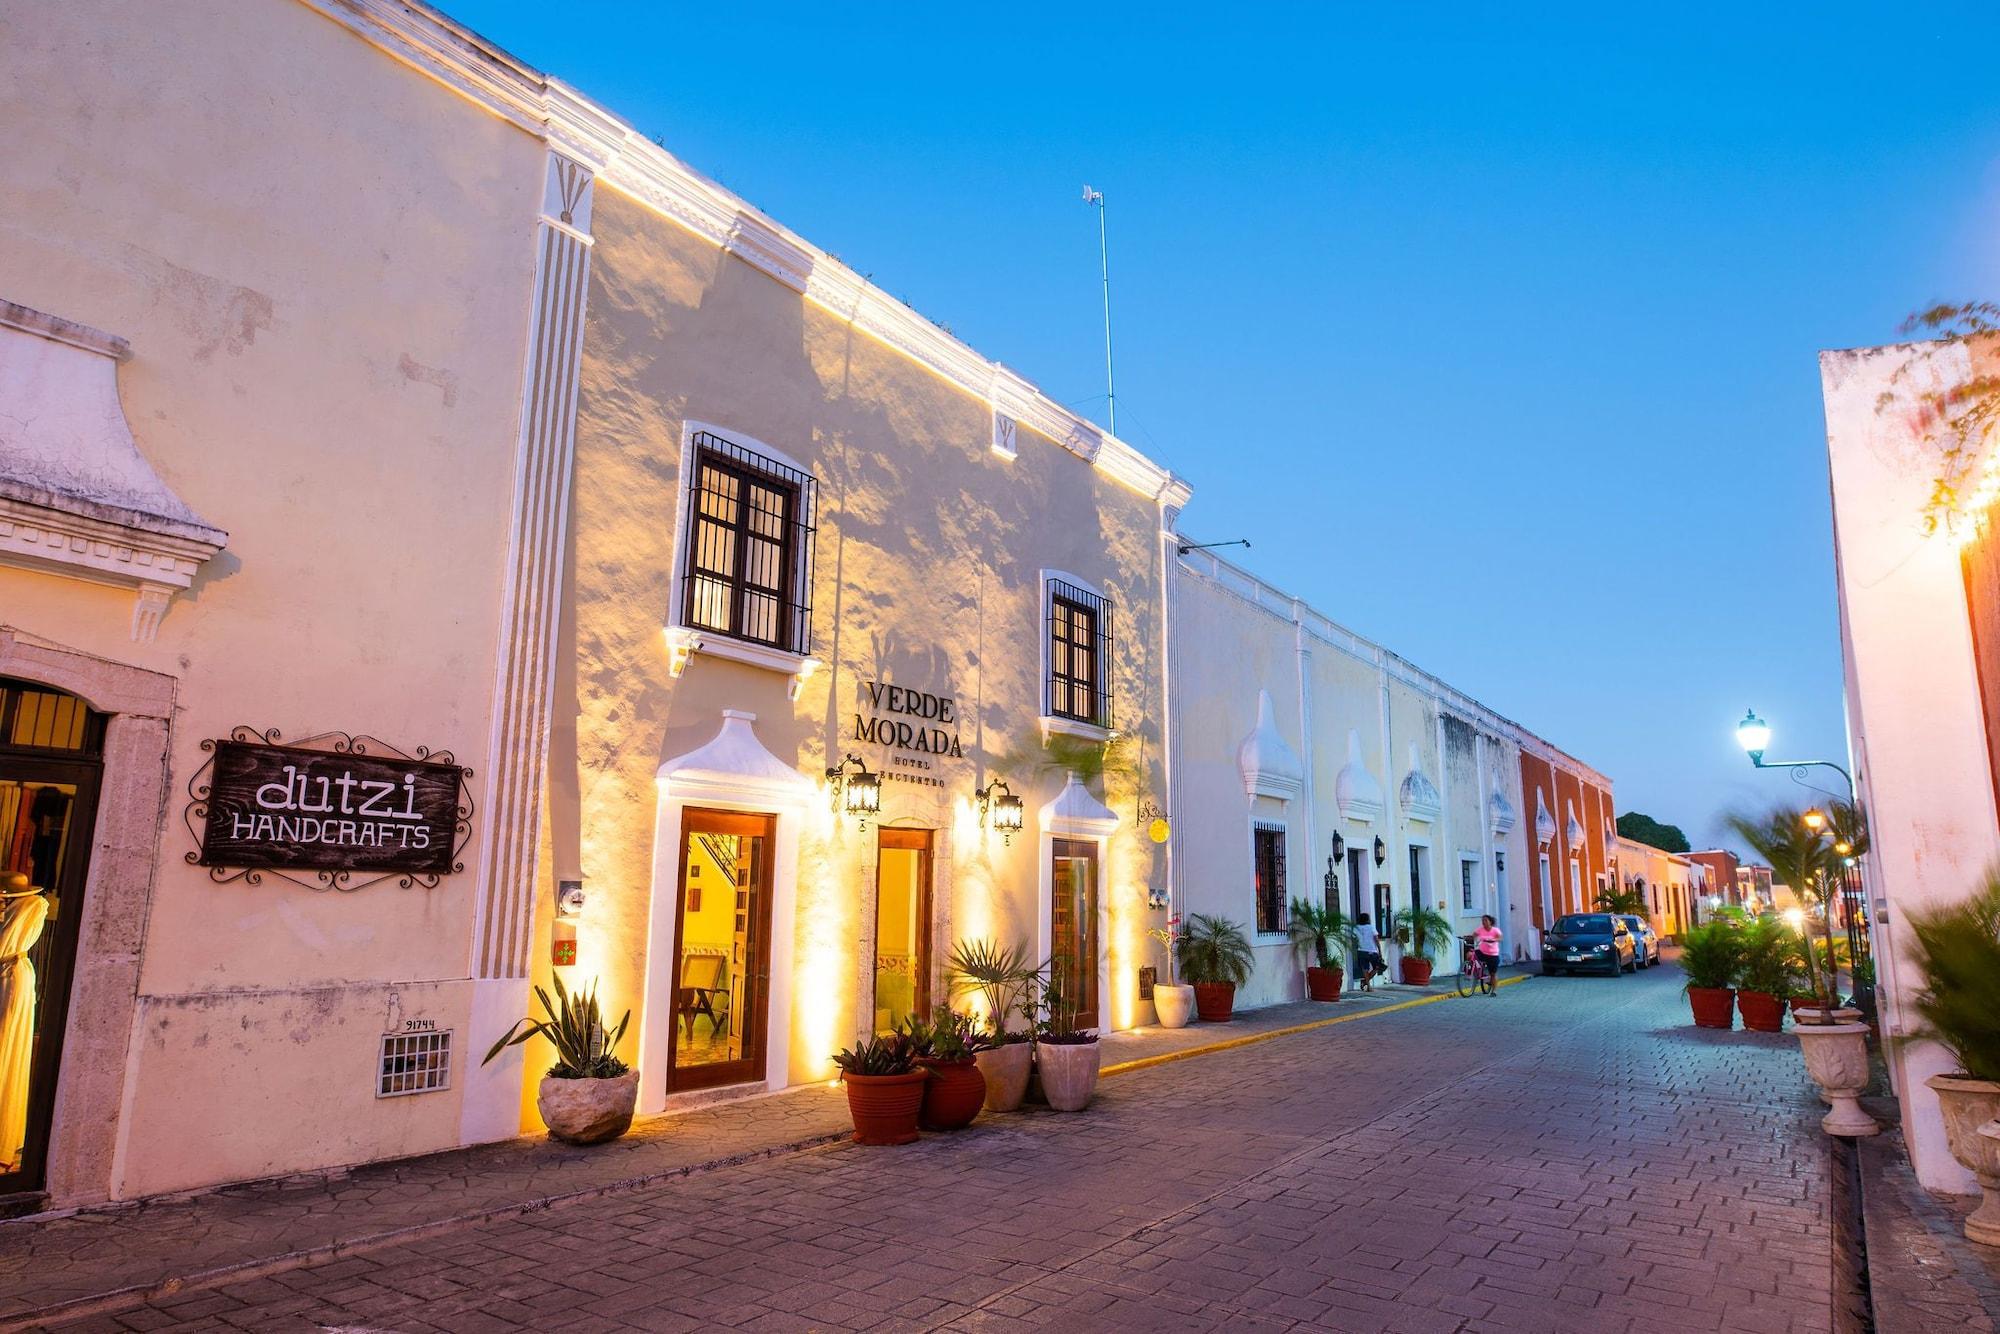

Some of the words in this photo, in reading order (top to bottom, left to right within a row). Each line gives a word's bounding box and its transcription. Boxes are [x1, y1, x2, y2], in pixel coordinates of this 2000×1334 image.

[866, 681, 954, 724] VERDE
[854, 713, 963, 758] MORADA
[895, 757, 930, 770] HOTEL
[256, 765, 423, 820] dutzi
[231, 812, 430, 849] HANDCRAFTS
